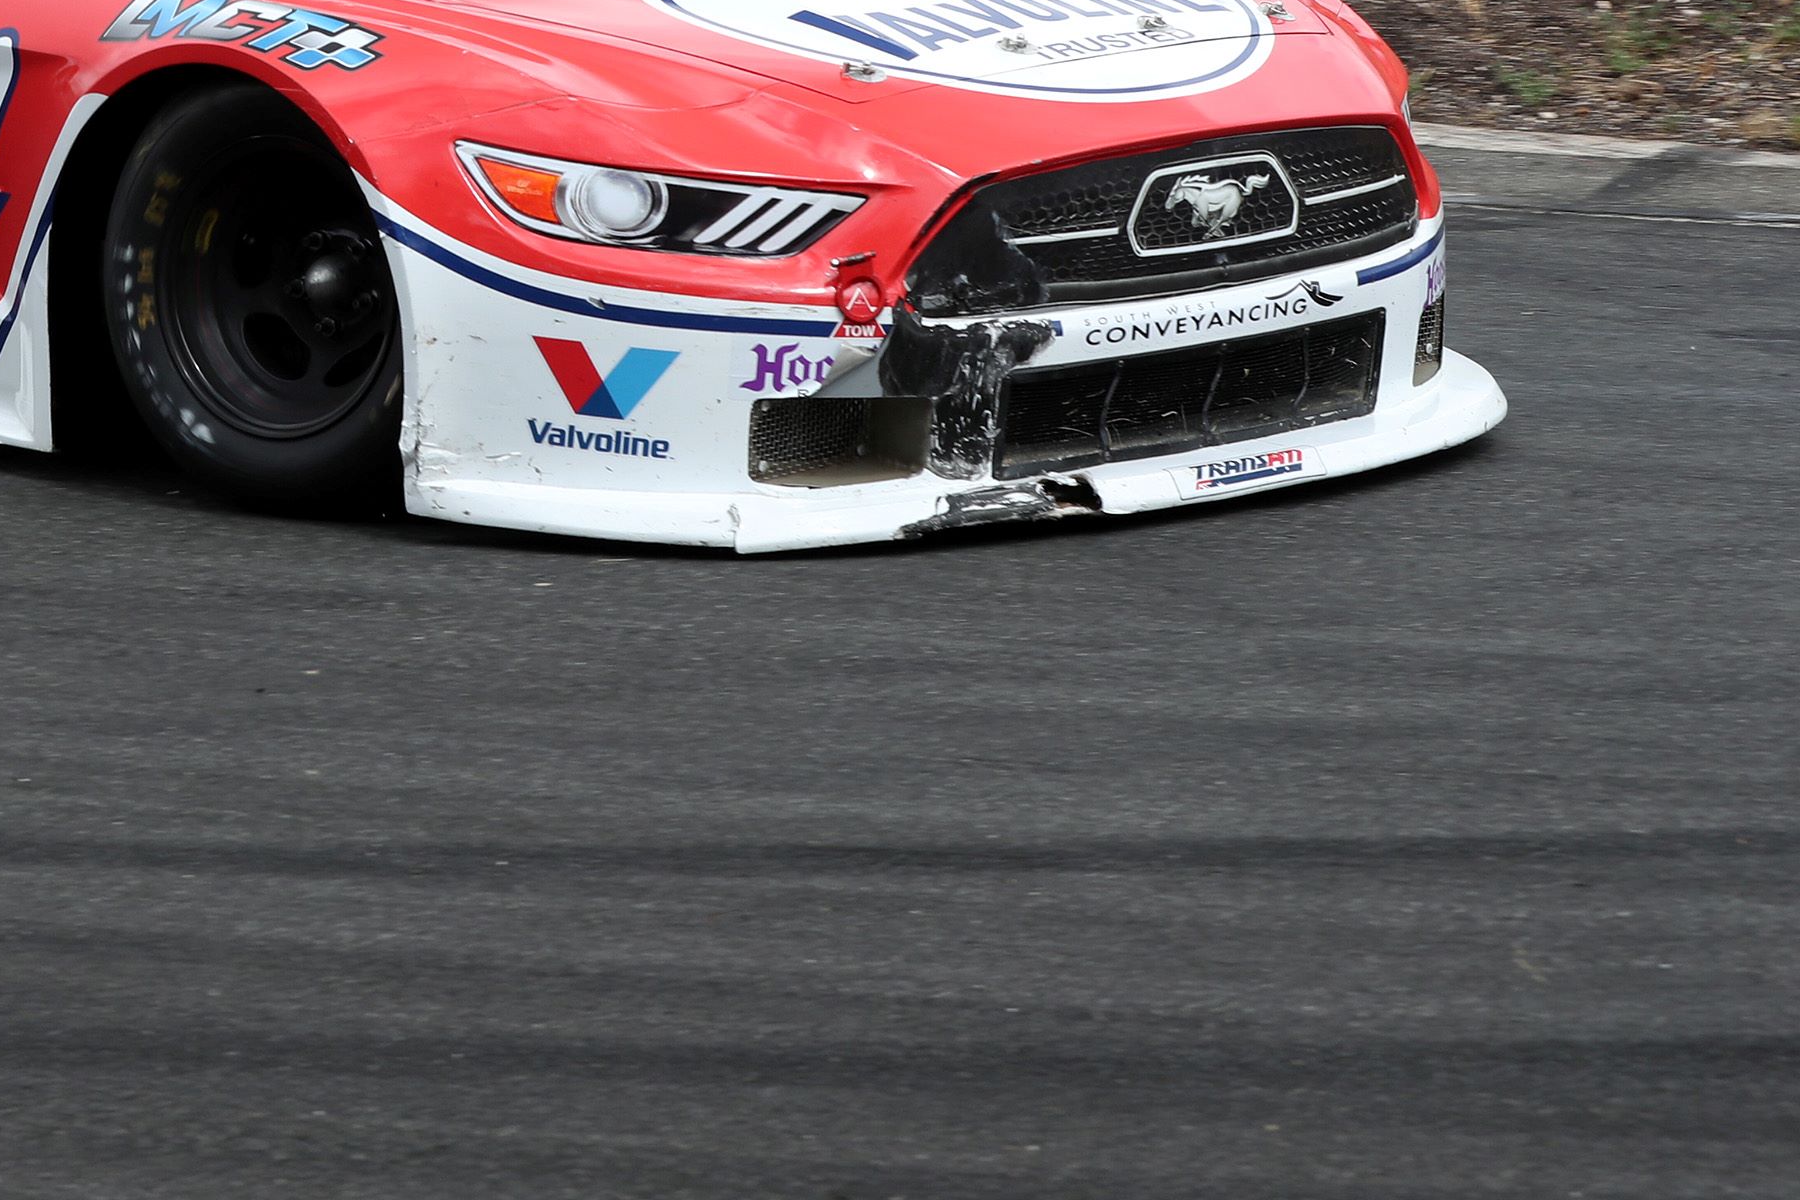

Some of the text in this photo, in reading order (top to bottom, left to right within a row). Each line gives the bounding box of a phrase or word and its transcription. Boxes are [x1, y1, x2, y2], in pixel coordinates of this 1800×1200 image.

[1036, 26, 1196, 61] TRUSTED
[843, 325, 876, 337] TOW
[1084, 301, 1217, 327] SOUTH WEST
[1085, 298, 1308, 347] CONVEYANCING
[527, 418, 671, 459] Valvoline
